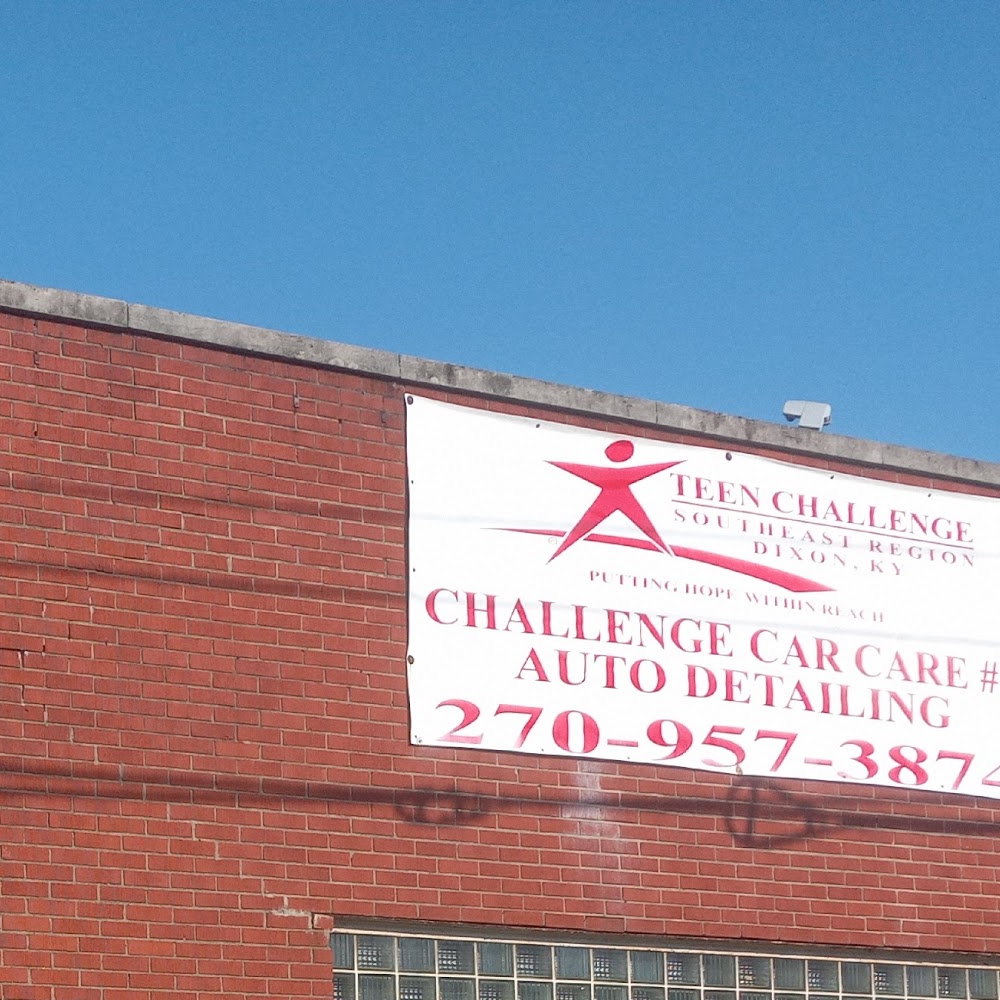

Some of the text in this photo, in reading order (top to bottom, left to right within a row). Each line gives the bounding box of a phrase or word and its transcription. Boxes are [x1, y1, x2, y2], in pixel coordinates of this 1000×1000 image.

[670, 473, 974, 543] TEEN CHALLENGE
[674, 508, 975, 567] SOUTHEAST REGION
[754, 541, 903, 576] DIXON, KY
[590, 570, 885, 623] PUTTING HOPE WITHIN REACH
[425, 588, 732, 657] CHALLENGE
[750, 629, 843, 672] CAR
[854, 644, 968, 689] CARE
[515, 647, 951, 728] AUTO DETAILING
